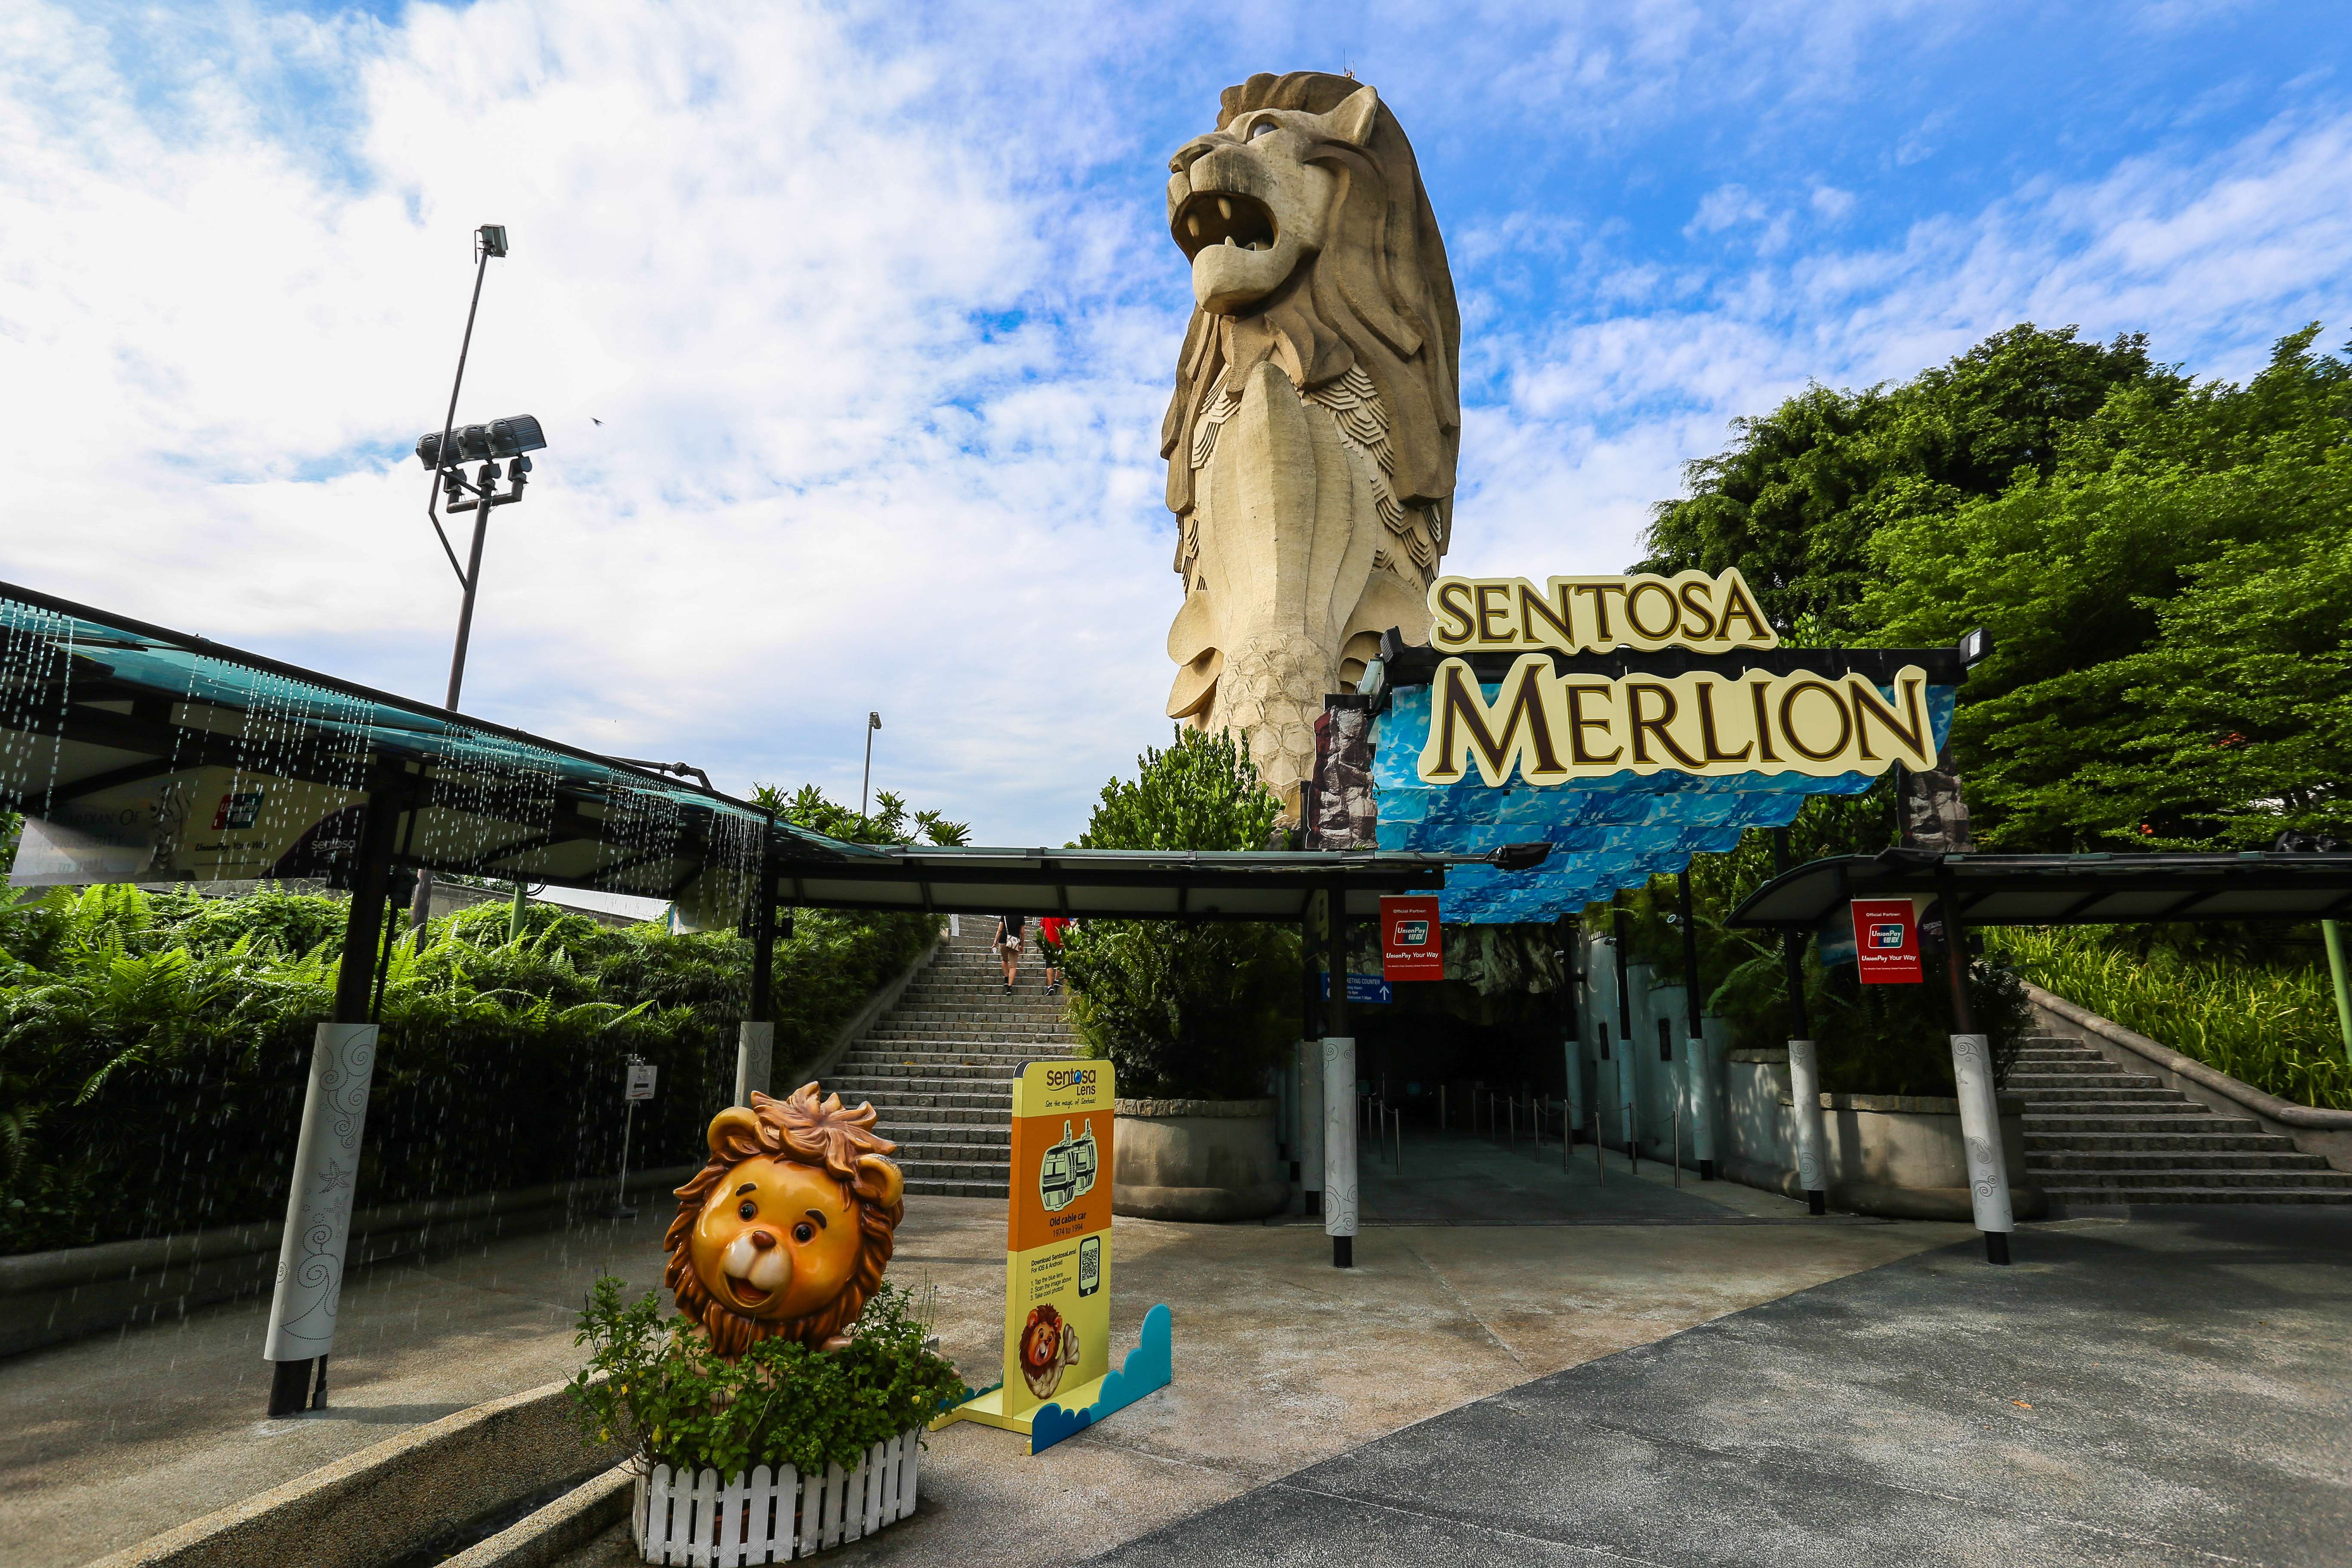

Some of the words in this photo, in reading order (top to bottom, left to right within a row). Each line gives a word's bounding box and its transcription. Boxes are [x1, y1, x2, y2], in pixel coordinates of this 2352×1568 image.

[1437, 575, 1772, 648] SENTOSA
[1428, 663, 1928, 779] MERLION
[195, 842, 230, 854] UnionPay
[233, 842, 250, 850] Your
[252, 841, 269, 850] Way
[1398, 927, 1425, 935] UnionPay
[1871, 930, 1901, 939] UnionPay
[1077, 1085, 1096, 1096] Lens
[1062, 1100, 1073, 1109] magic
[1050, 1216, 1060, 1227] Old
[1061, 1213, 1077, 1224] cable
[1078, 1212, 1087, 1220] car
[1053, 1228, 1065, 1238] 1974
[1072, 1223, 1083, 1233] 1994
[1031, 1256, 1051, 1266] Download
[1052, 1248, 1077, 1260] SentosaLens!
[1049, 1259, 1063, 1268] Android
[1051, 1285, 1064, 1295] photos!
